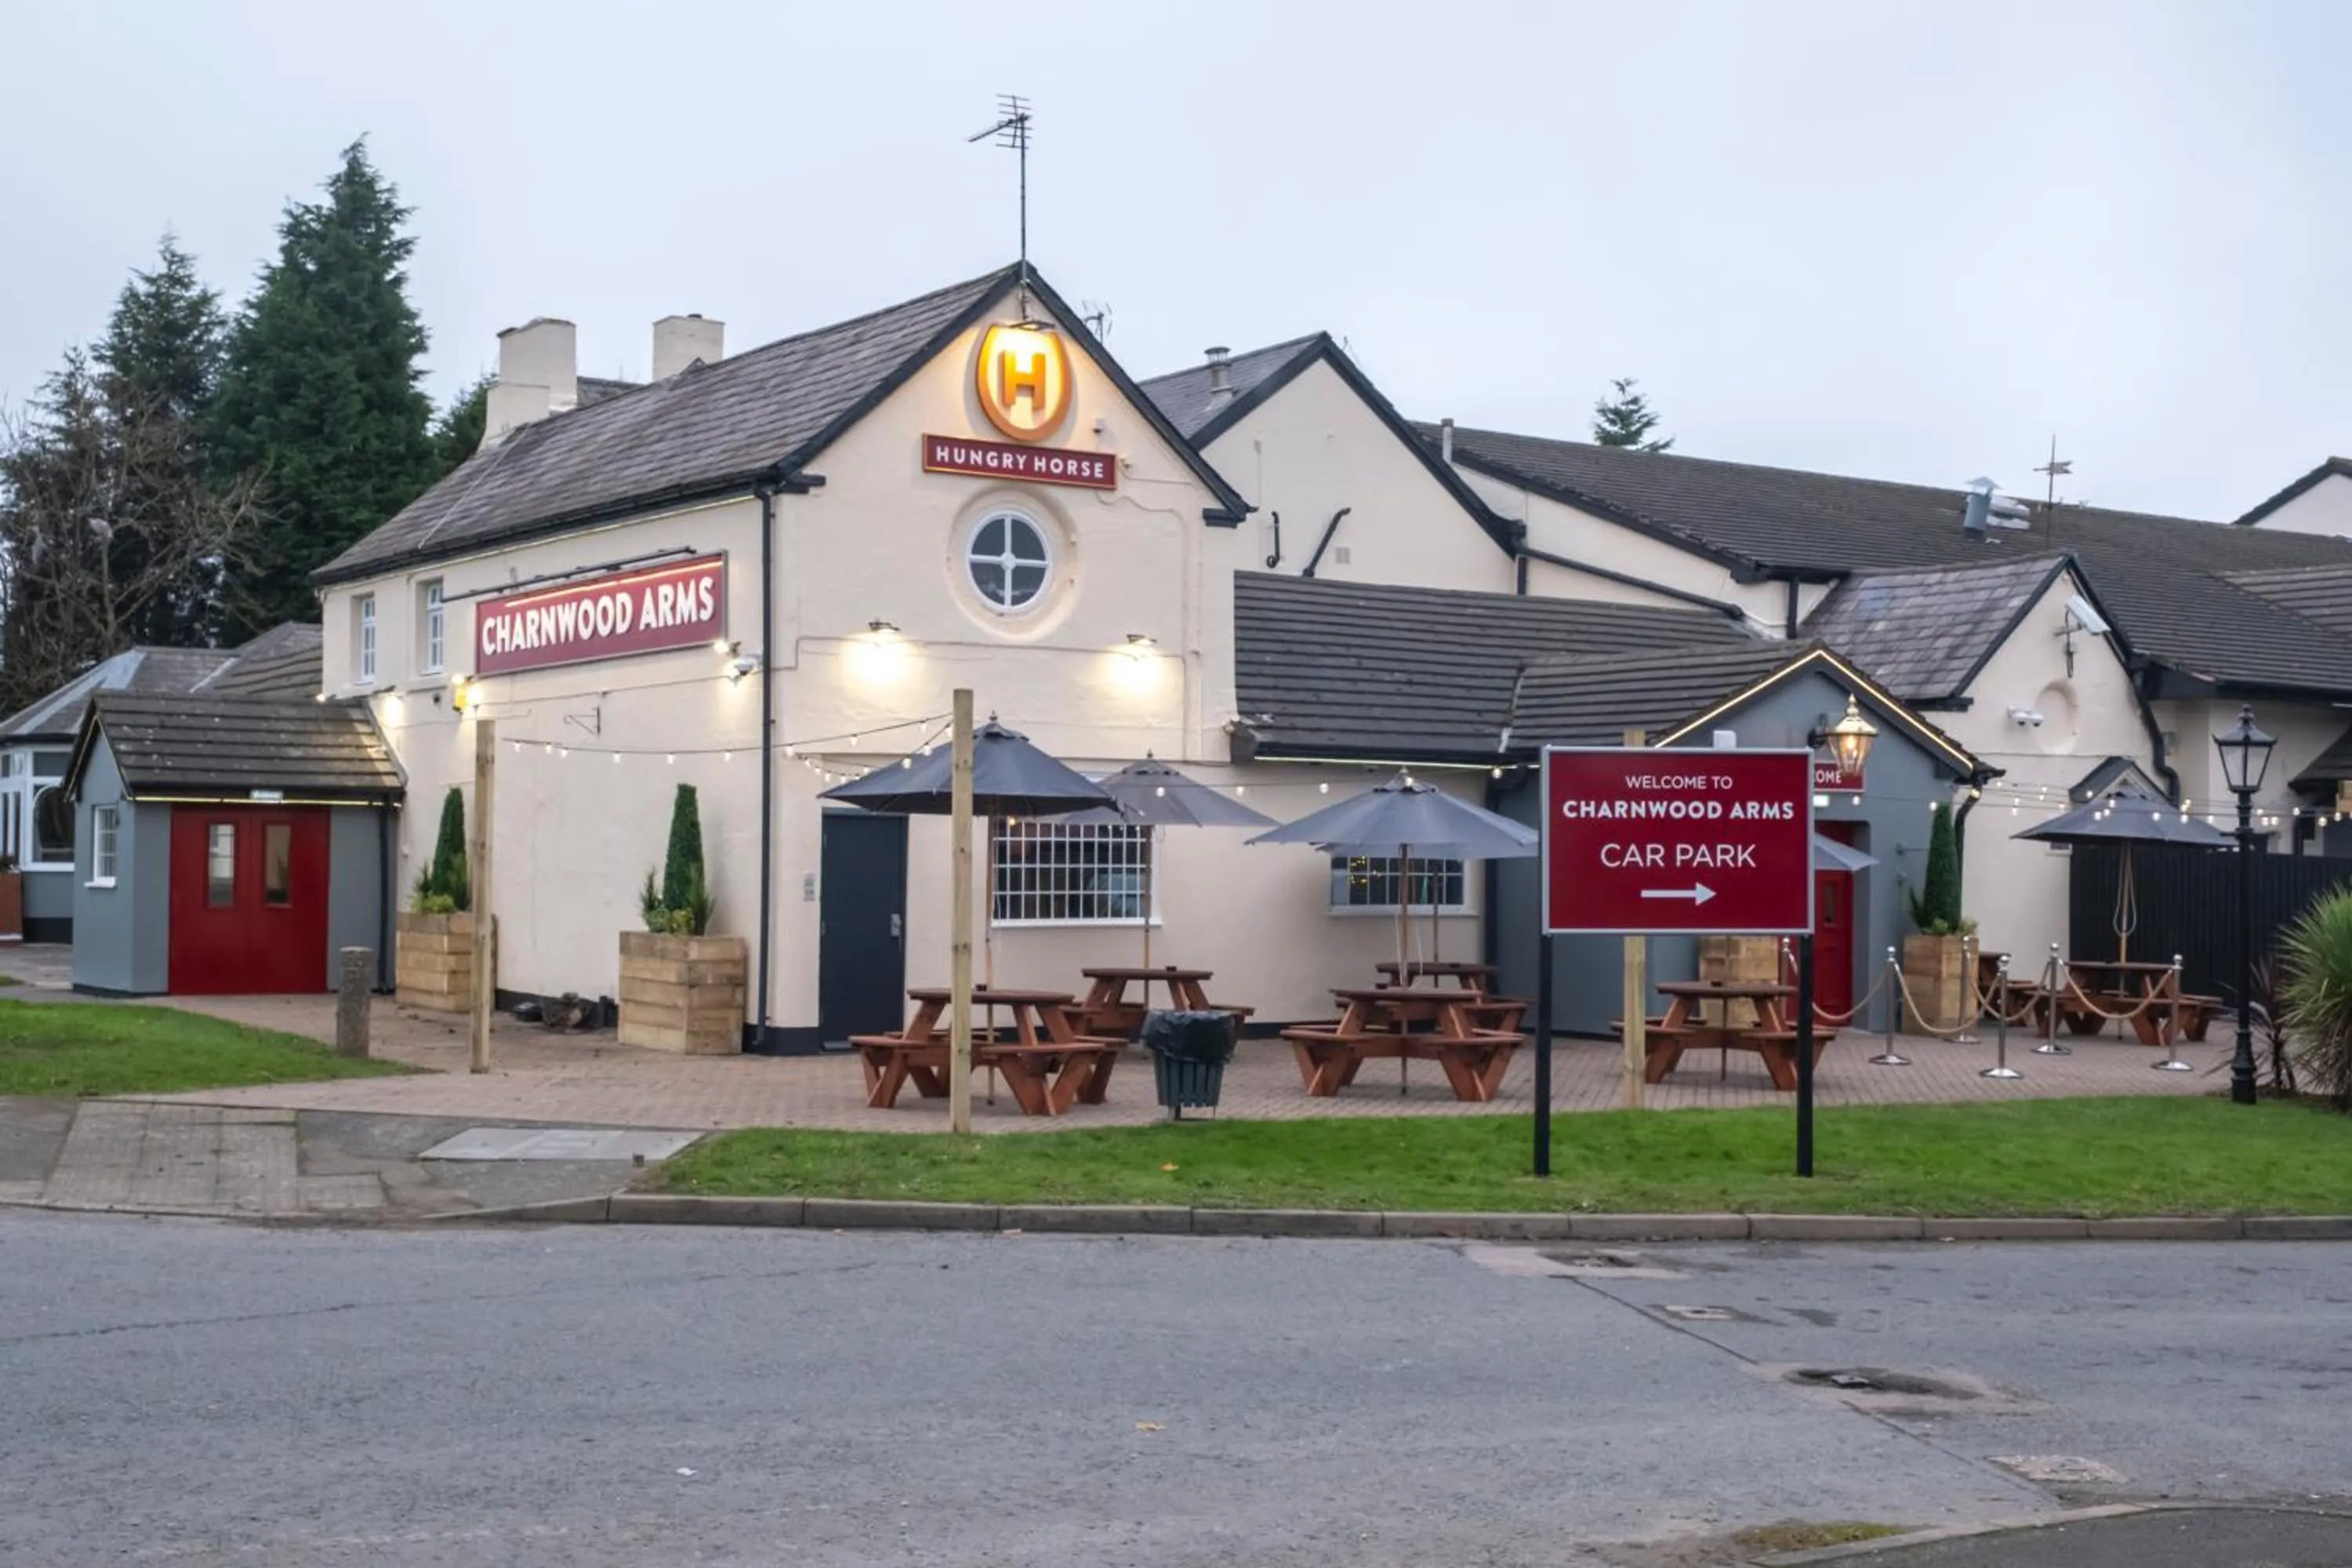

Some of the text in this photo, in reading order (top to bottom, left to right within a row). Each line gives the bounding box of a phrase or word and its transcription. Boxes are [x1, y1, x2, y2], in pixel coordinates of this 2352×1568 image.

[1000, 350, 1047, 409] H
[936, 445, 1104, 478] HUNGRY HORSE
[481, 576, 714, 655] CHARNWOOD ARMS
[1626, 775, 1733, 789] WELCOME TO
[1563, 800, 1795, 820] CHARNWOOD ARMS
[1600, 843, 1757, 868] CAR PARK
